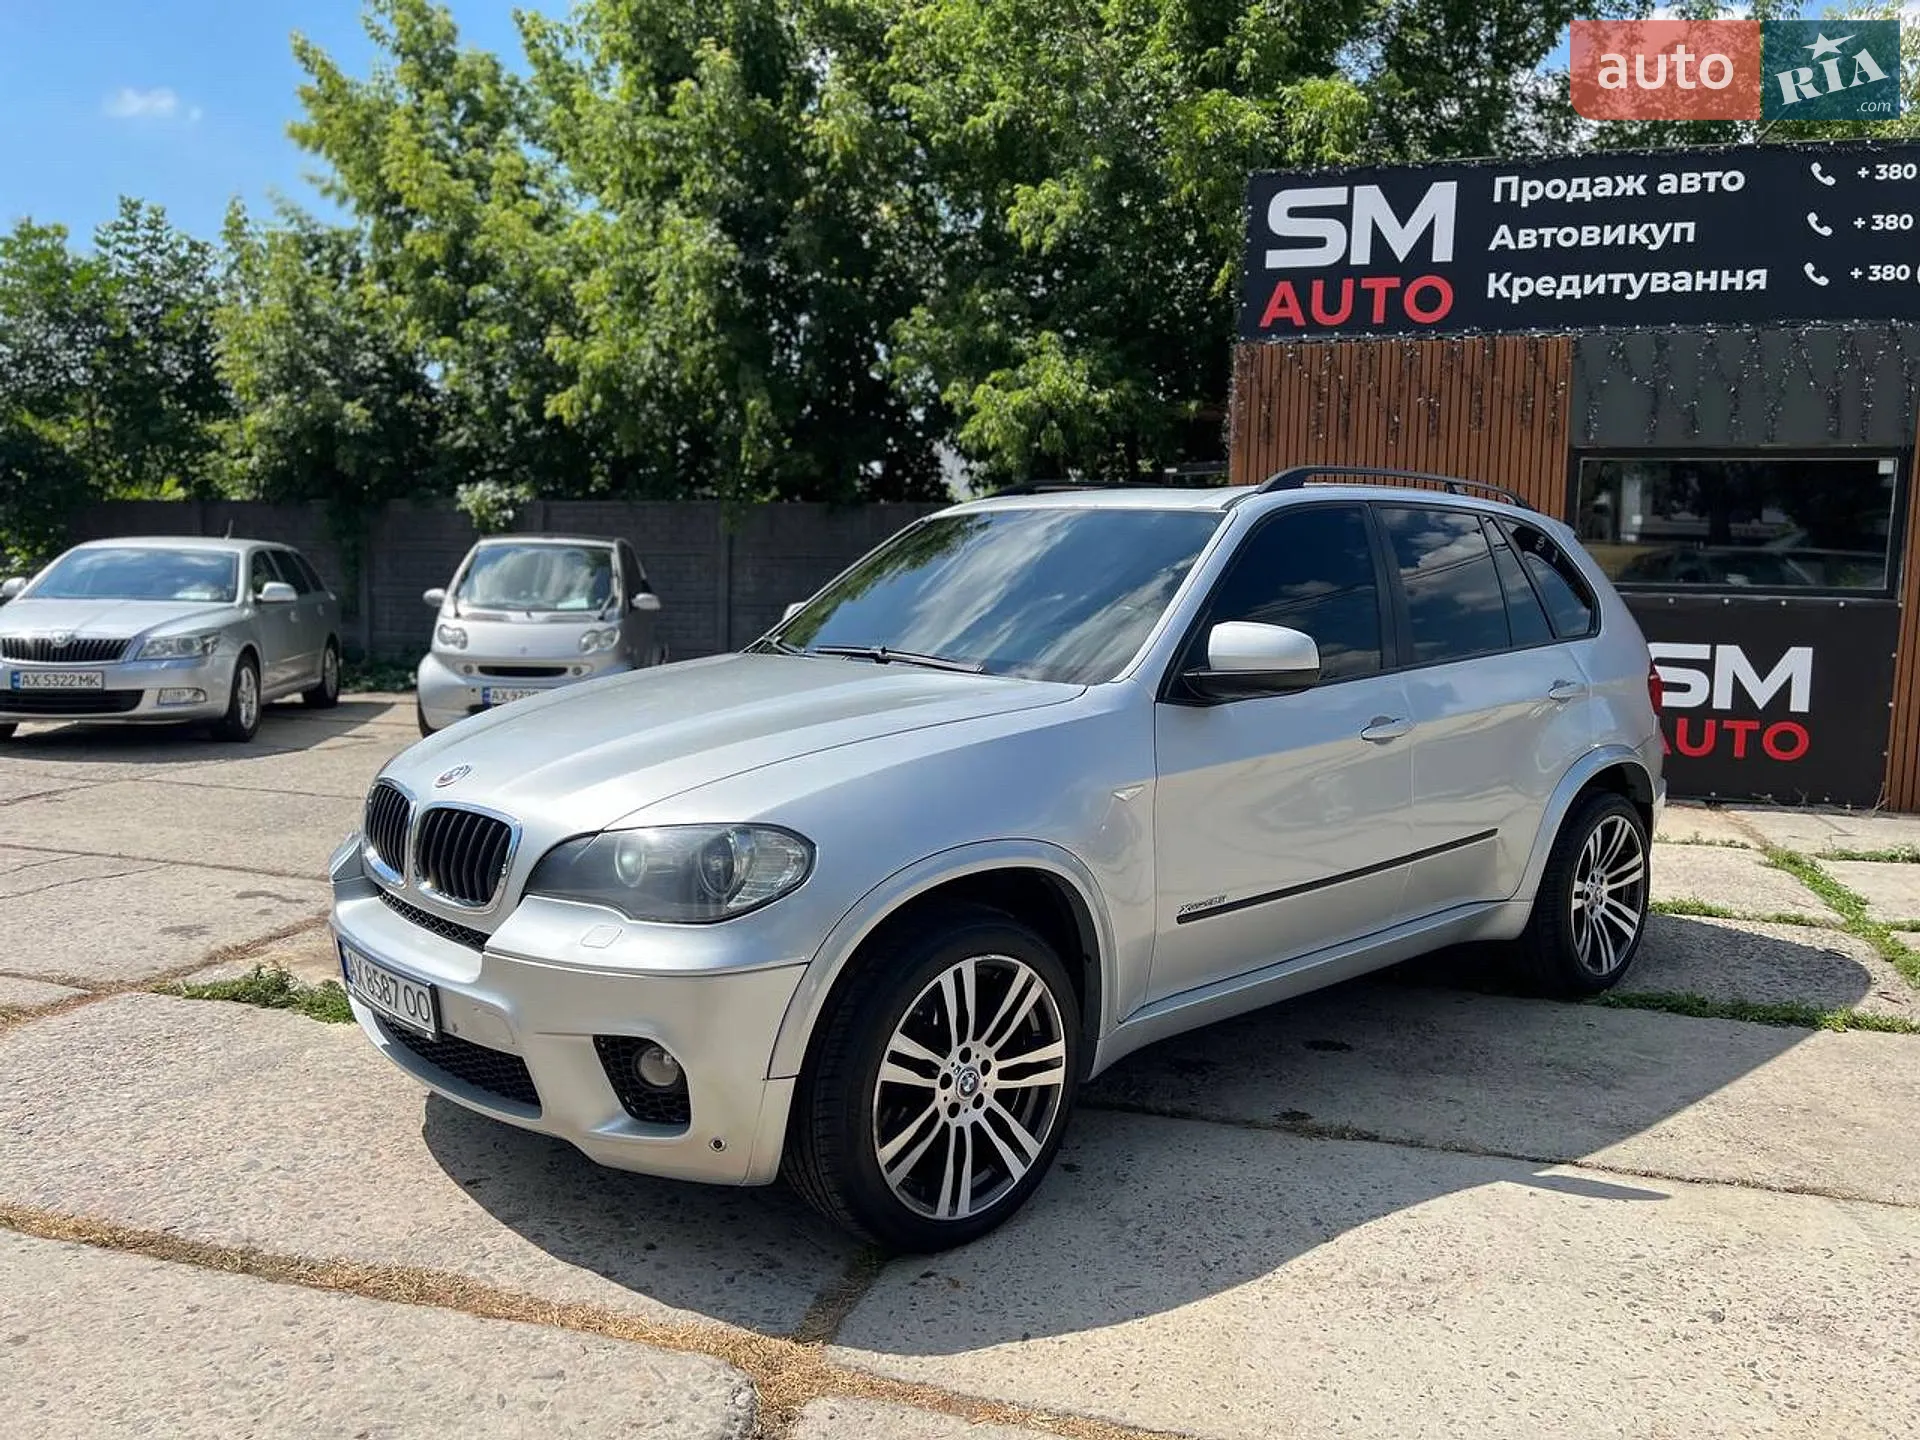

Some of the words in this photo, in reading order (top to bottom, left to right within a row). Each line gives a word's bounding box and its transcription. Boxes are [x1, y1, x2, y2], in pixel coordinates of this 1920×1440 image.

[1493, 174, 1648, 208] Продаж
[1657, 170, 1745, 195] авто
[1265, 181, 1458, 269] SM
[1488, 221, 1696, 251] Автовикуп
[1260, 275, 1454, 328] AUTO
[1487, 269, 1768, 304] Кредитування
[22, 673, 40, 687] AX
[79, 672, 99, 687] MK
[1648, 642, 1813, 712] SM
[1664, 717, 1810, 762] UTO
[365, 964, 399, 1010] 8587
